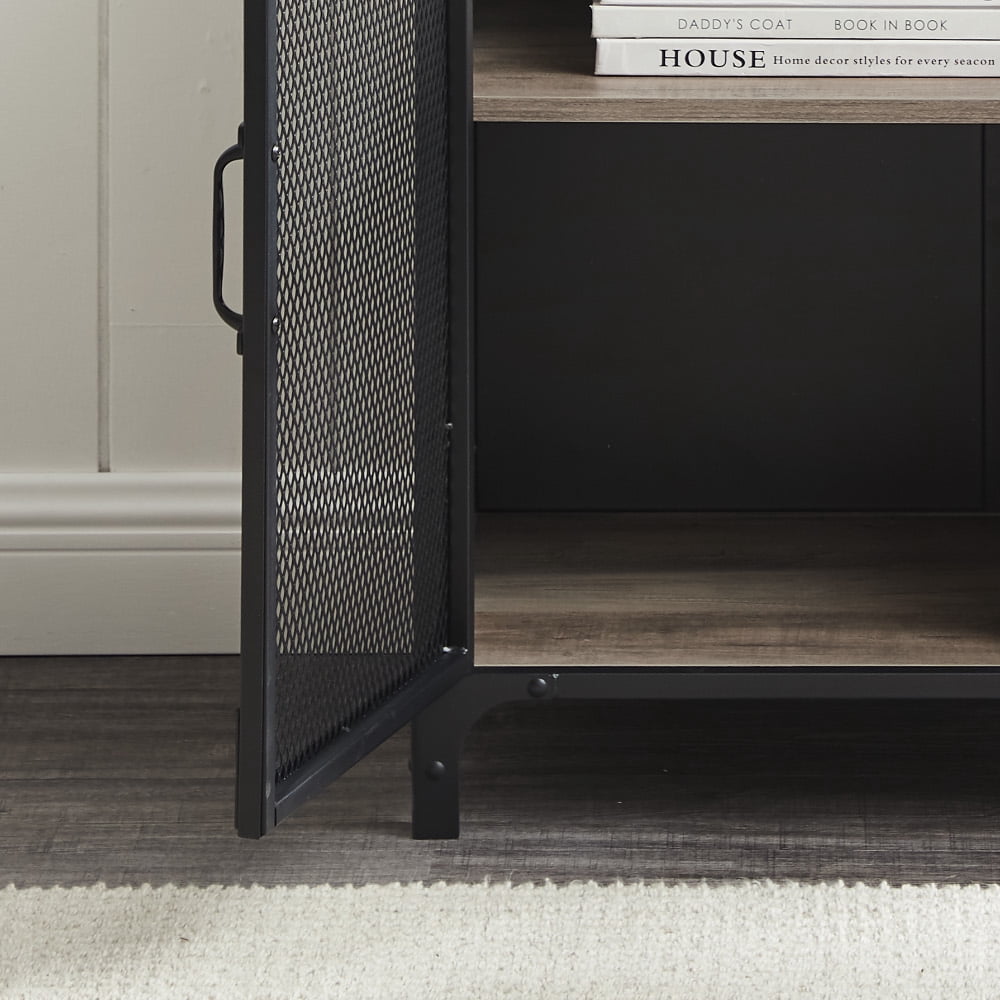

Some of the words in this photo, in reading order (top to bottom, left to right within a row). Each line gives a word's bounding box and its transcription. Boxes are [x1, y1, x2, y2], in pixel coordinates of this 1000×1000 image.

[678, 18, 744, 31] DADDY'S
[749, 18, 793, 31] COAT
[834, 19, 877, 31] BOOK
[883, 19, 898, 31] IN
[904, 19, 948, 31] BOOK
[659, 49, 766, 69] HOUSE
[773, 55, 811, 65] Home
[814, 55, 850, 65] decor
[895, 55, 914, 66] for
[917, 58, 951, 68] every
[954, 58, 996, 67] seacon
